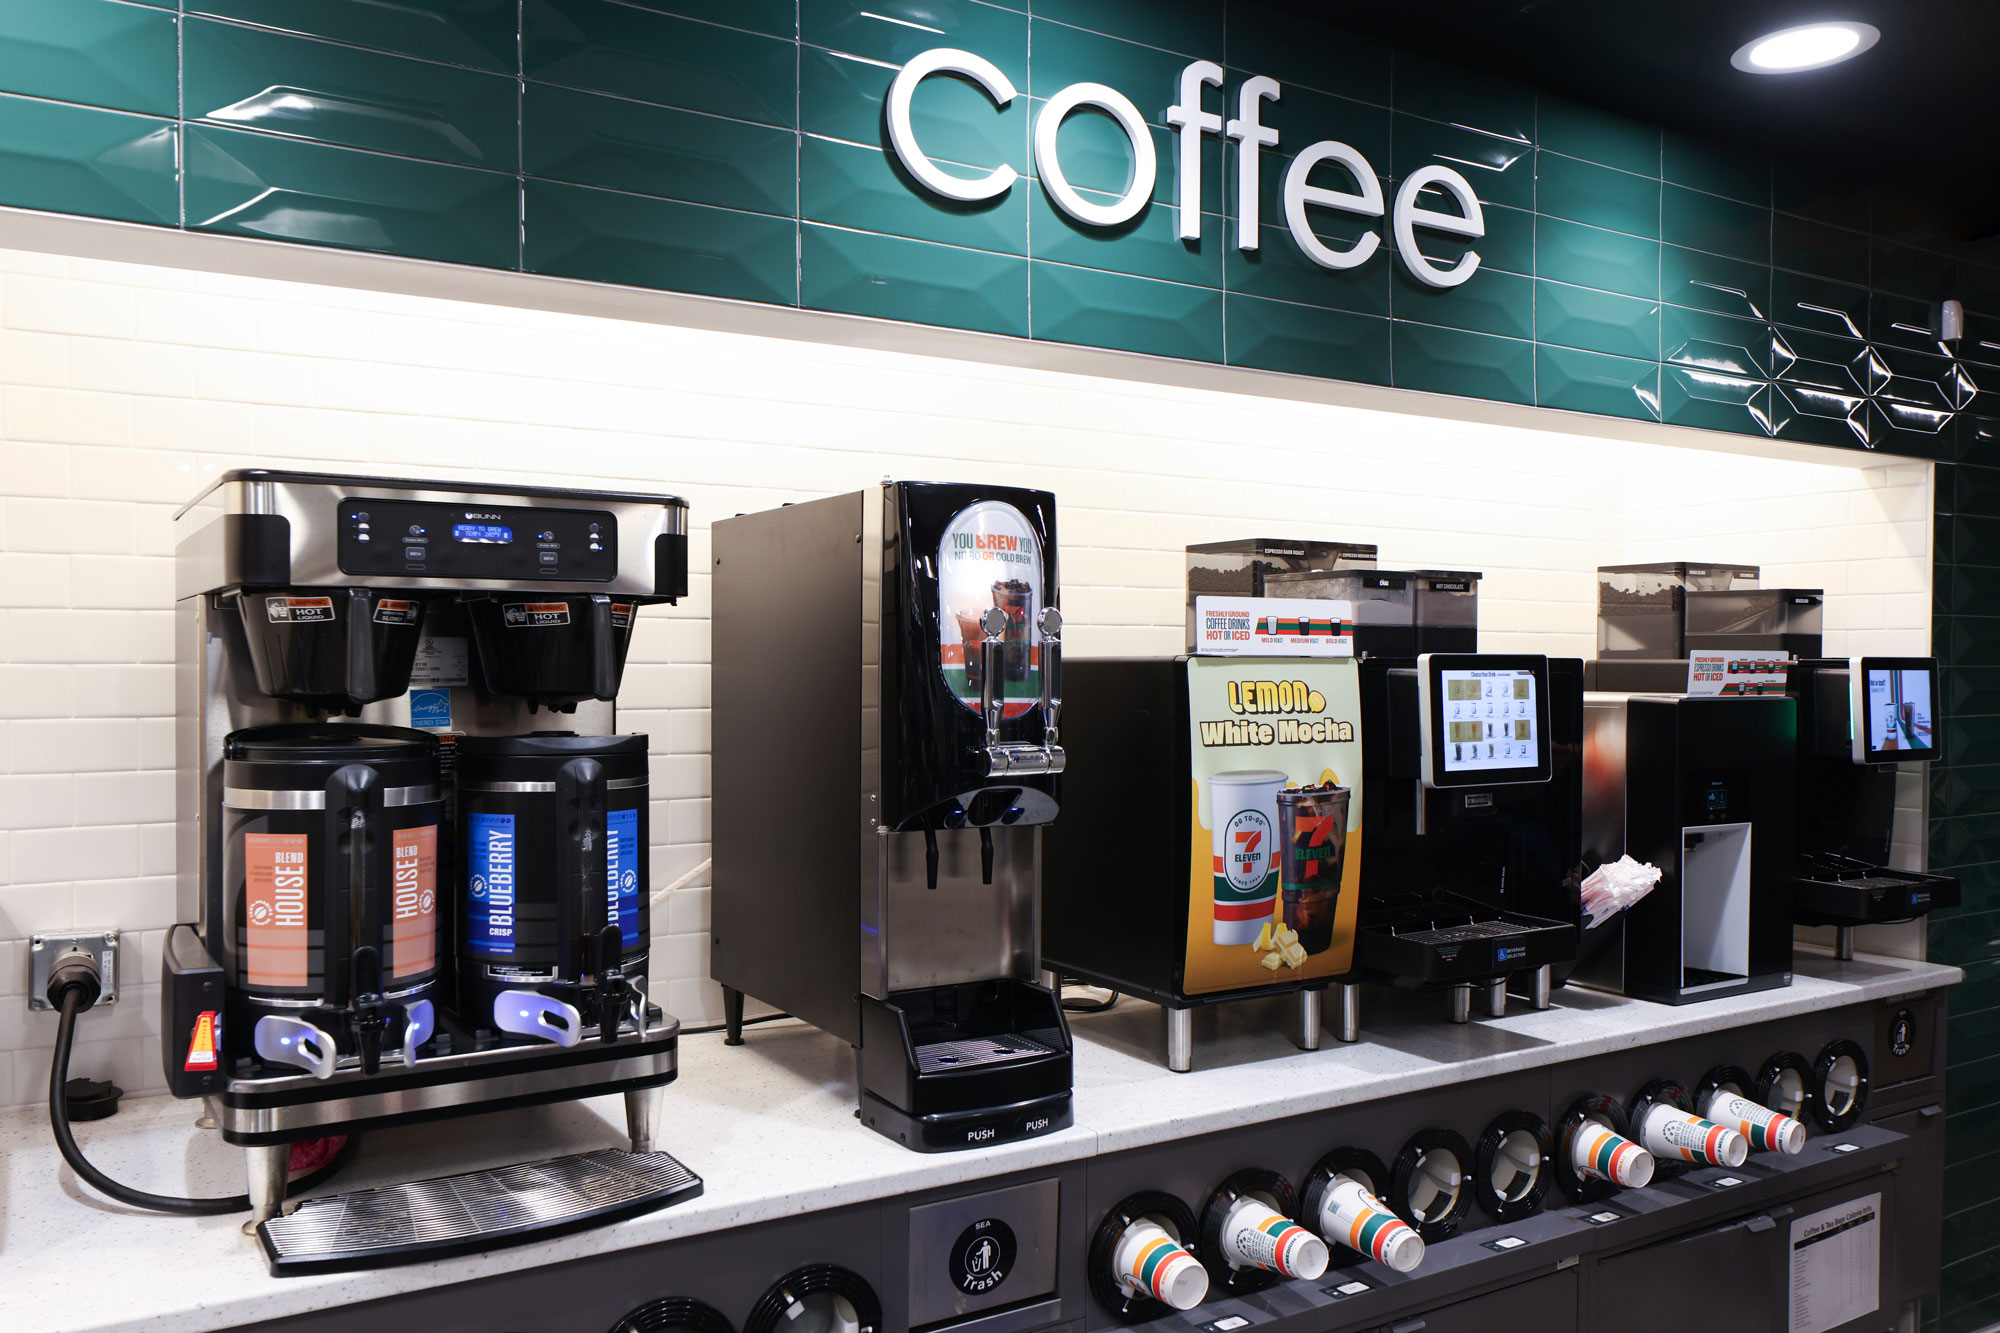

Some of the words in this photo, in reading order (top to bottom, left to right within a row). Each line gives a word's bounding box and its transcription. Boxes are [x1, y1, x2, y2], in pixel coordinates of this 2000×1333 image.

[887, 47, 1485, 288] coffee
[952, 533, 973, 548] YOU
[976, 534, 1017, 551] BREW
[1019, 537, 1032, 553] YOU
[982, 552, 994, 560] OR
[996, 552, 1014, 562] COLD
[1016, 554, 1031, 564] BREW
[1206, 618, 1227, 629] COFFEE
[1228, 618, 1250, 630] DRINKS
[1206, 631, 1223, 640] HOT
[1224, 631, 1231, 640] OR
[1232, 632, 1250, 640] ICED
[1694, 673, 1704, 681] HOT
[1710, 673, 1723, 681] ICED
[1228, 681, 1309, 713] LEMON
[1200, 720, 1274, 747] White
[1278, 718, 1353, 743] Mocha
[275, 852, 304, 863] BLEND
[396, 845, 418, 858] BLEND
[489, 830, 512, 926] BLUEBERRY
[1234, 877, 1247, 886] SINCE
[396, 858, 418, 919] HOUSE
[275, 866, 304, 926] HOUSE
[489, 928, 512, 936] CRISP
[1892, 1044, 1910, 1055] Trash
[1026, 1118, 1048, 1131] PUSH
[968, 1128, 994, 1141] PUSH
[976, 1220, 991, 1229] SEA
[1804, 1226, 1820, 1237] Coffee
[1826, 1221, 1834, 1229] Tea
[1835, 1217, 1845, 1226] Bags
[1846, 1209, 1863, 1220] Calorie
[1863, 1205, 1872, 1214] Info
[1286, 1238, 1296, 1264] MEDIUM
[963, 1270, 1002, 1290] Trash
